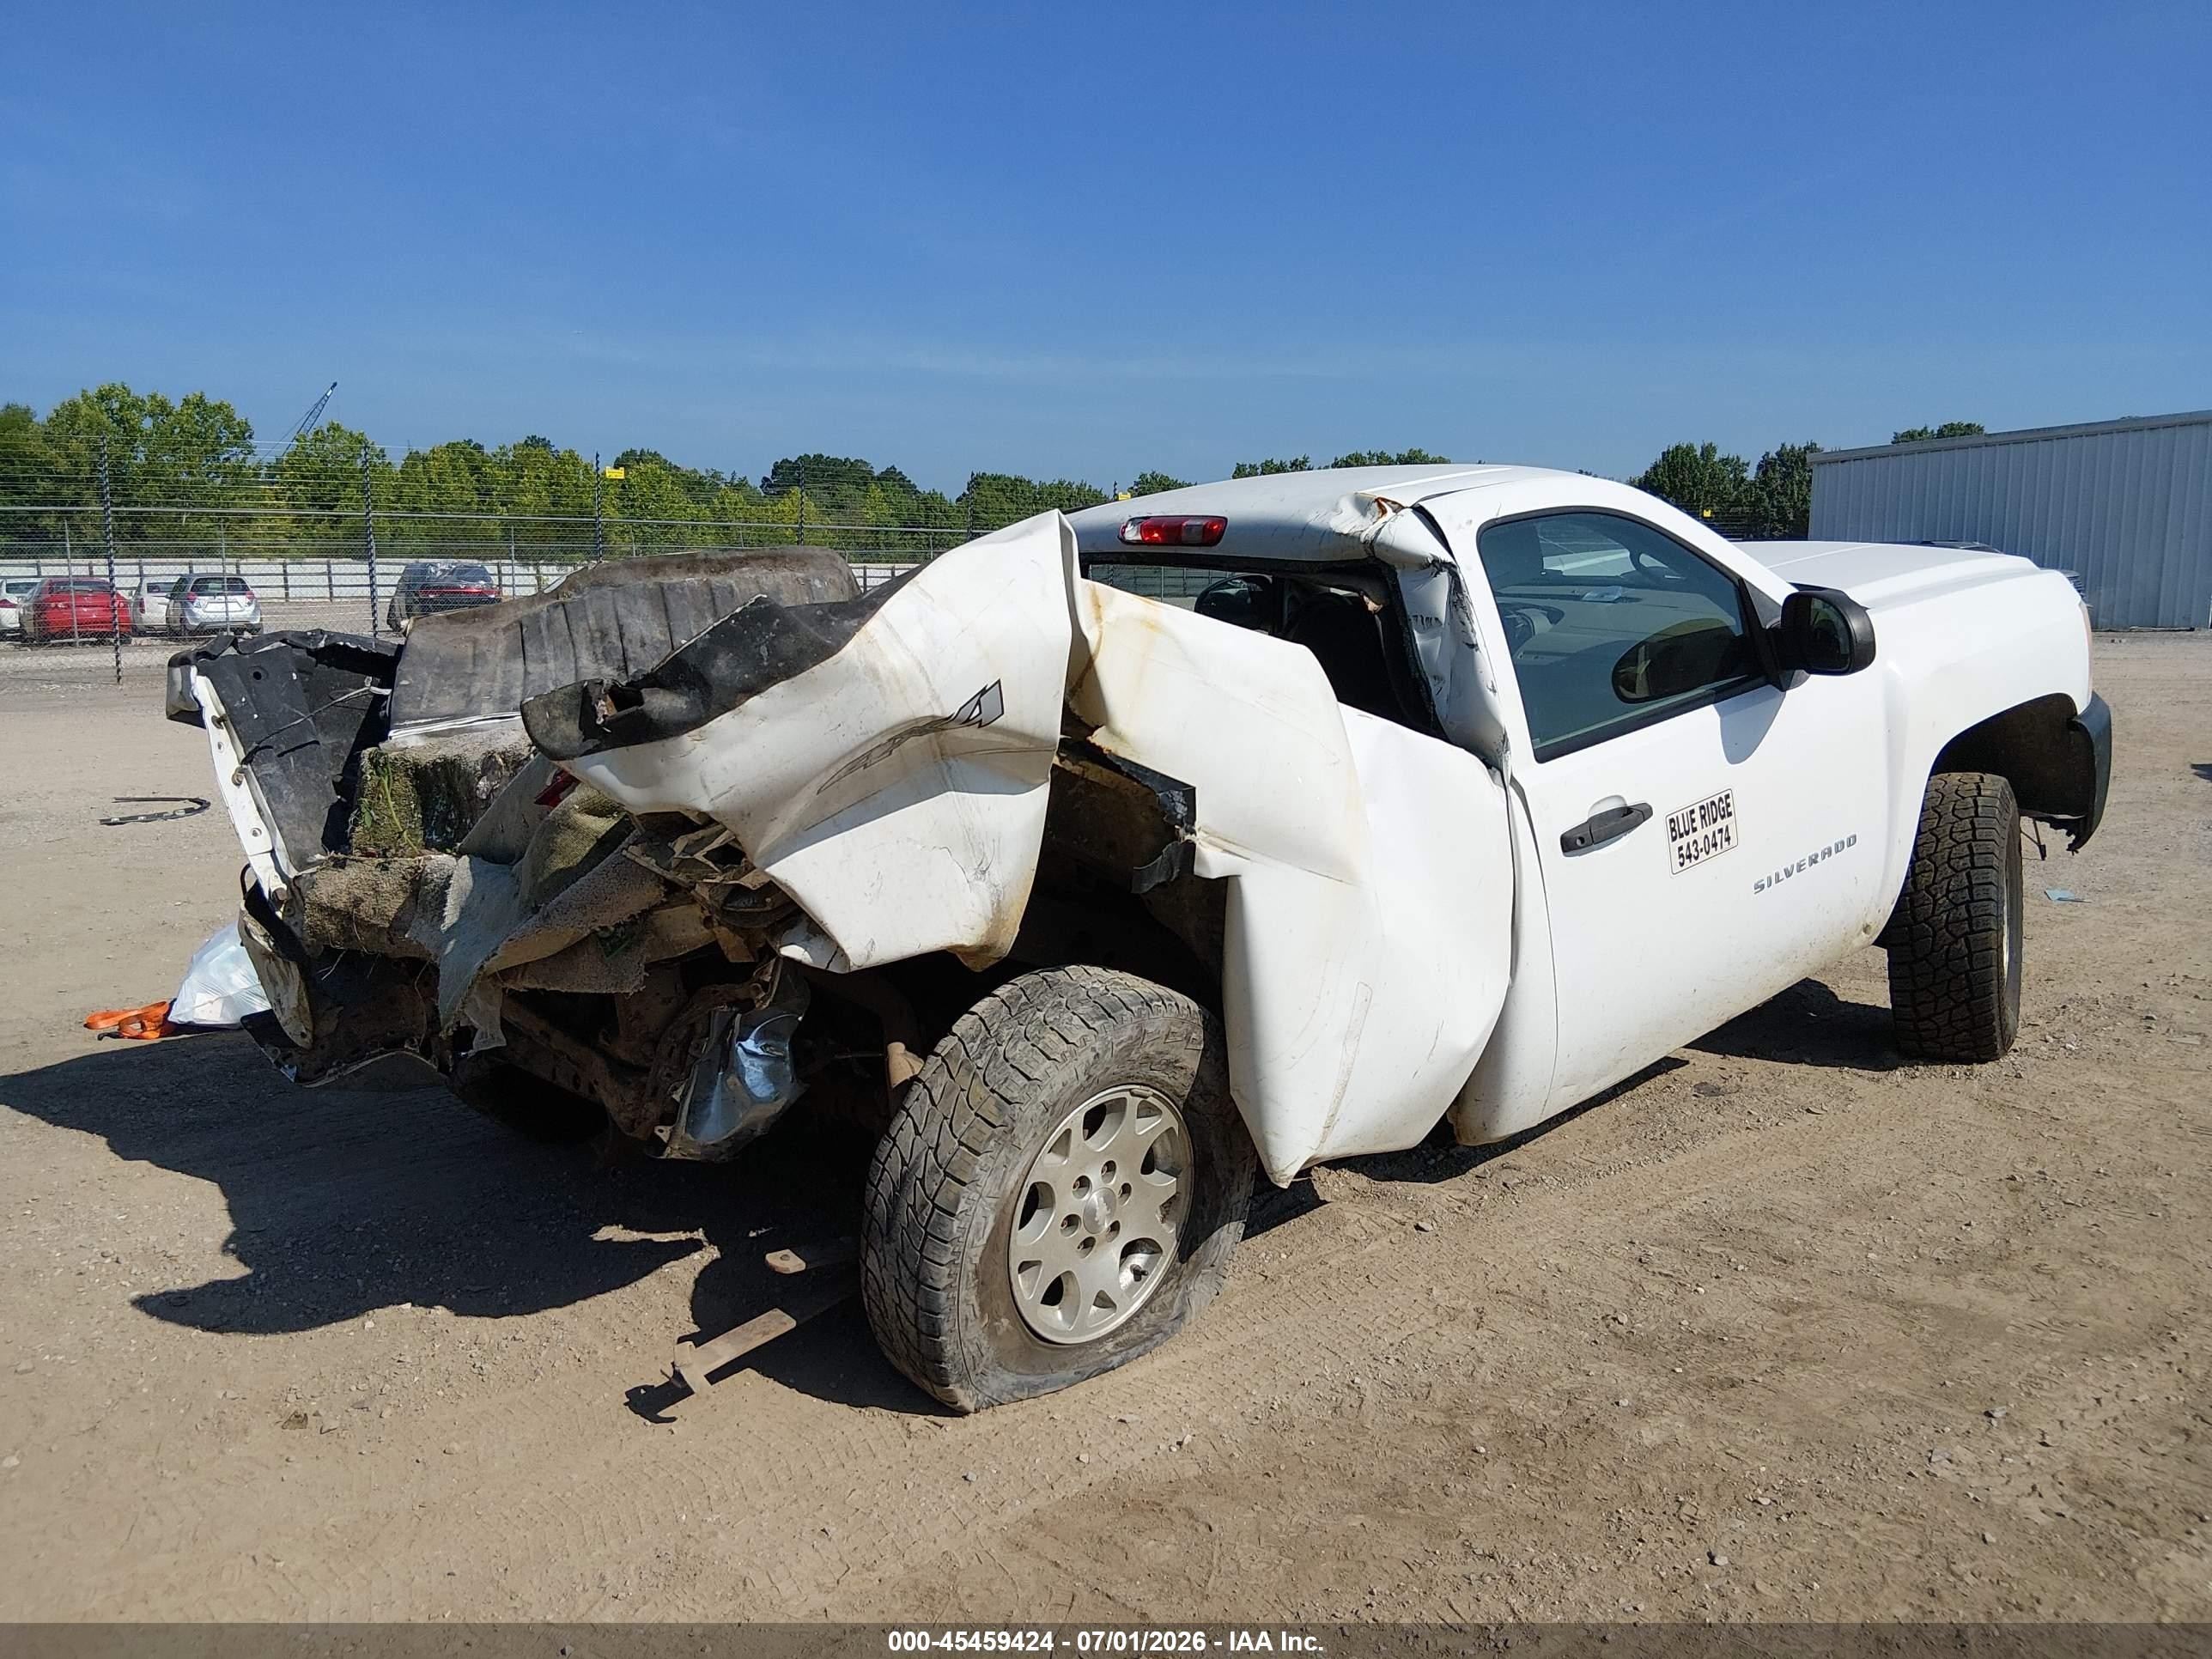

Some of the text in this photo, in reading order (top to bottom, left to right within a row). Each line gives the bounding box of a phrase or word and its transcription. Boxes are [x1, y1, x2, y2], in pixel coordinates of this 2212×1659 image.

[1668, 793, 1733, 843] BLUE RIDGE
[1677, 824, 1731, 867] 543-0474
[1753, 833, 1857, 895] SILVERADO
